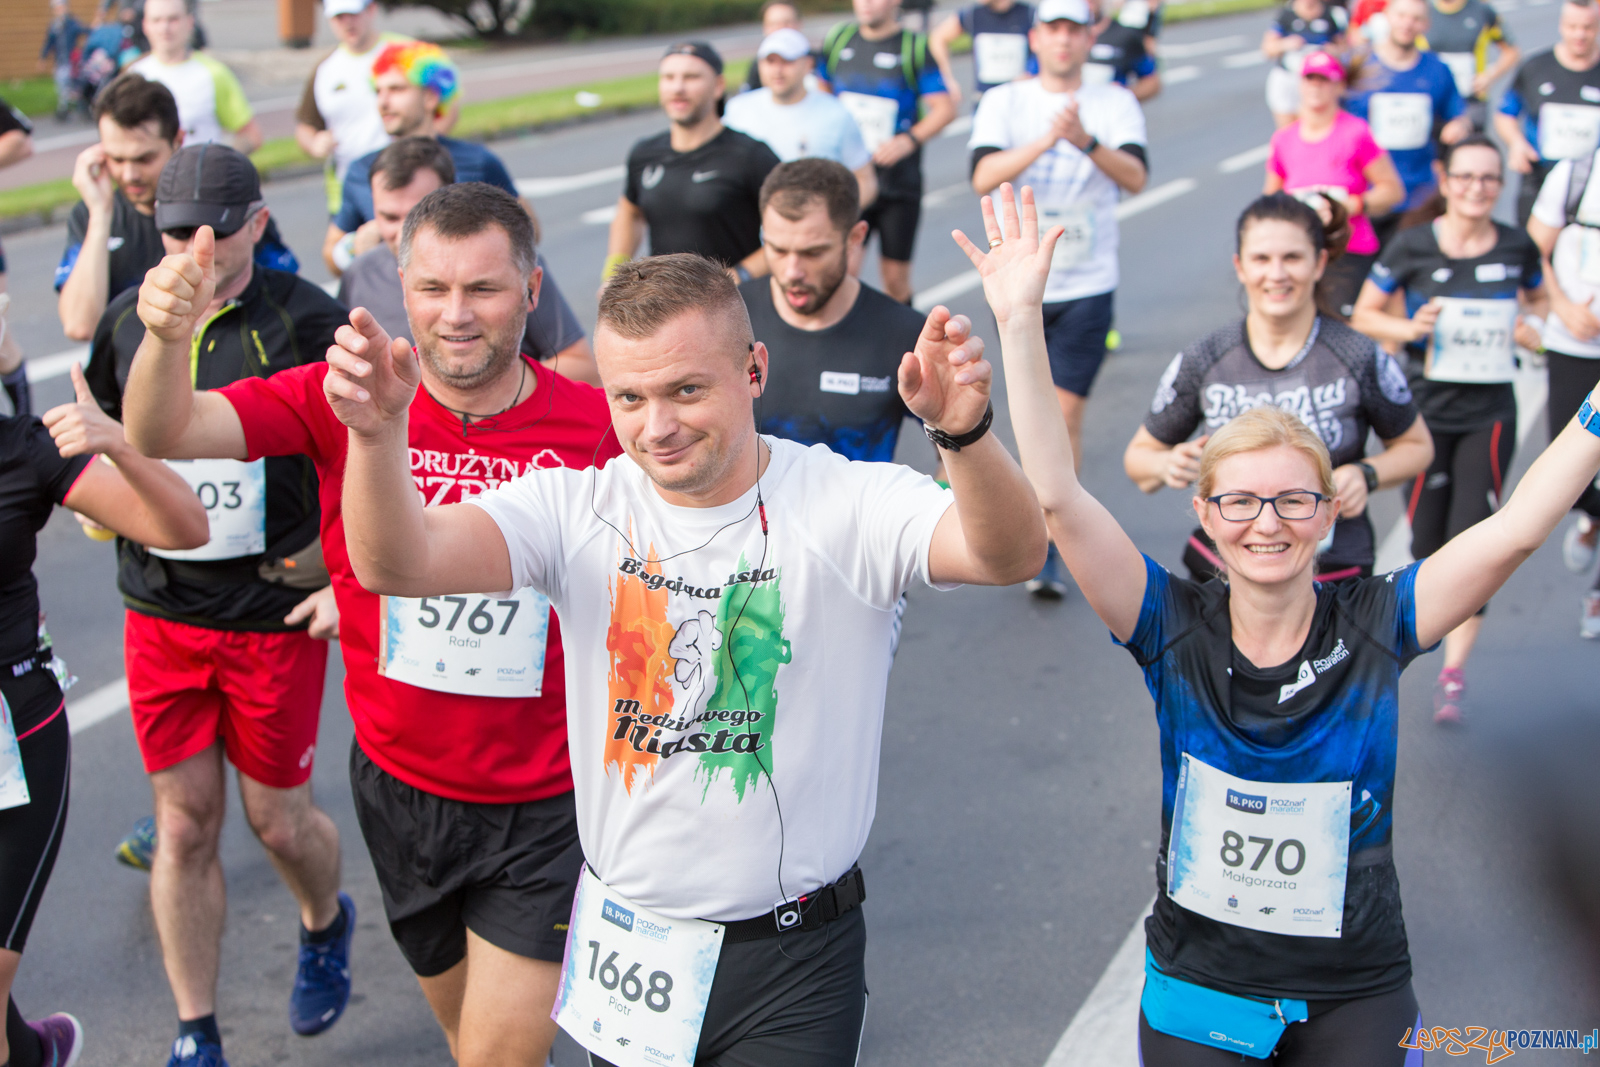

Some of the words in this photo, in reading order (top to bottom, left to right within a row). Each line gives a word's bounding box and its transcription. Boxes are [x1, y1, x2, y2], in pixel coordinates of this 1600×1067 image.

[418, 596, 520, 636] 5767
[449, 635, 481, 649] Rafal
[1220, 830, 1306, 876] 870
[1222, 868, 1297, 890] Małgorzata
[635, 926, 668, 942] maraton
[588, 940, 673, 1013] 1668
[608, 996, 632, 1016] Piotr
